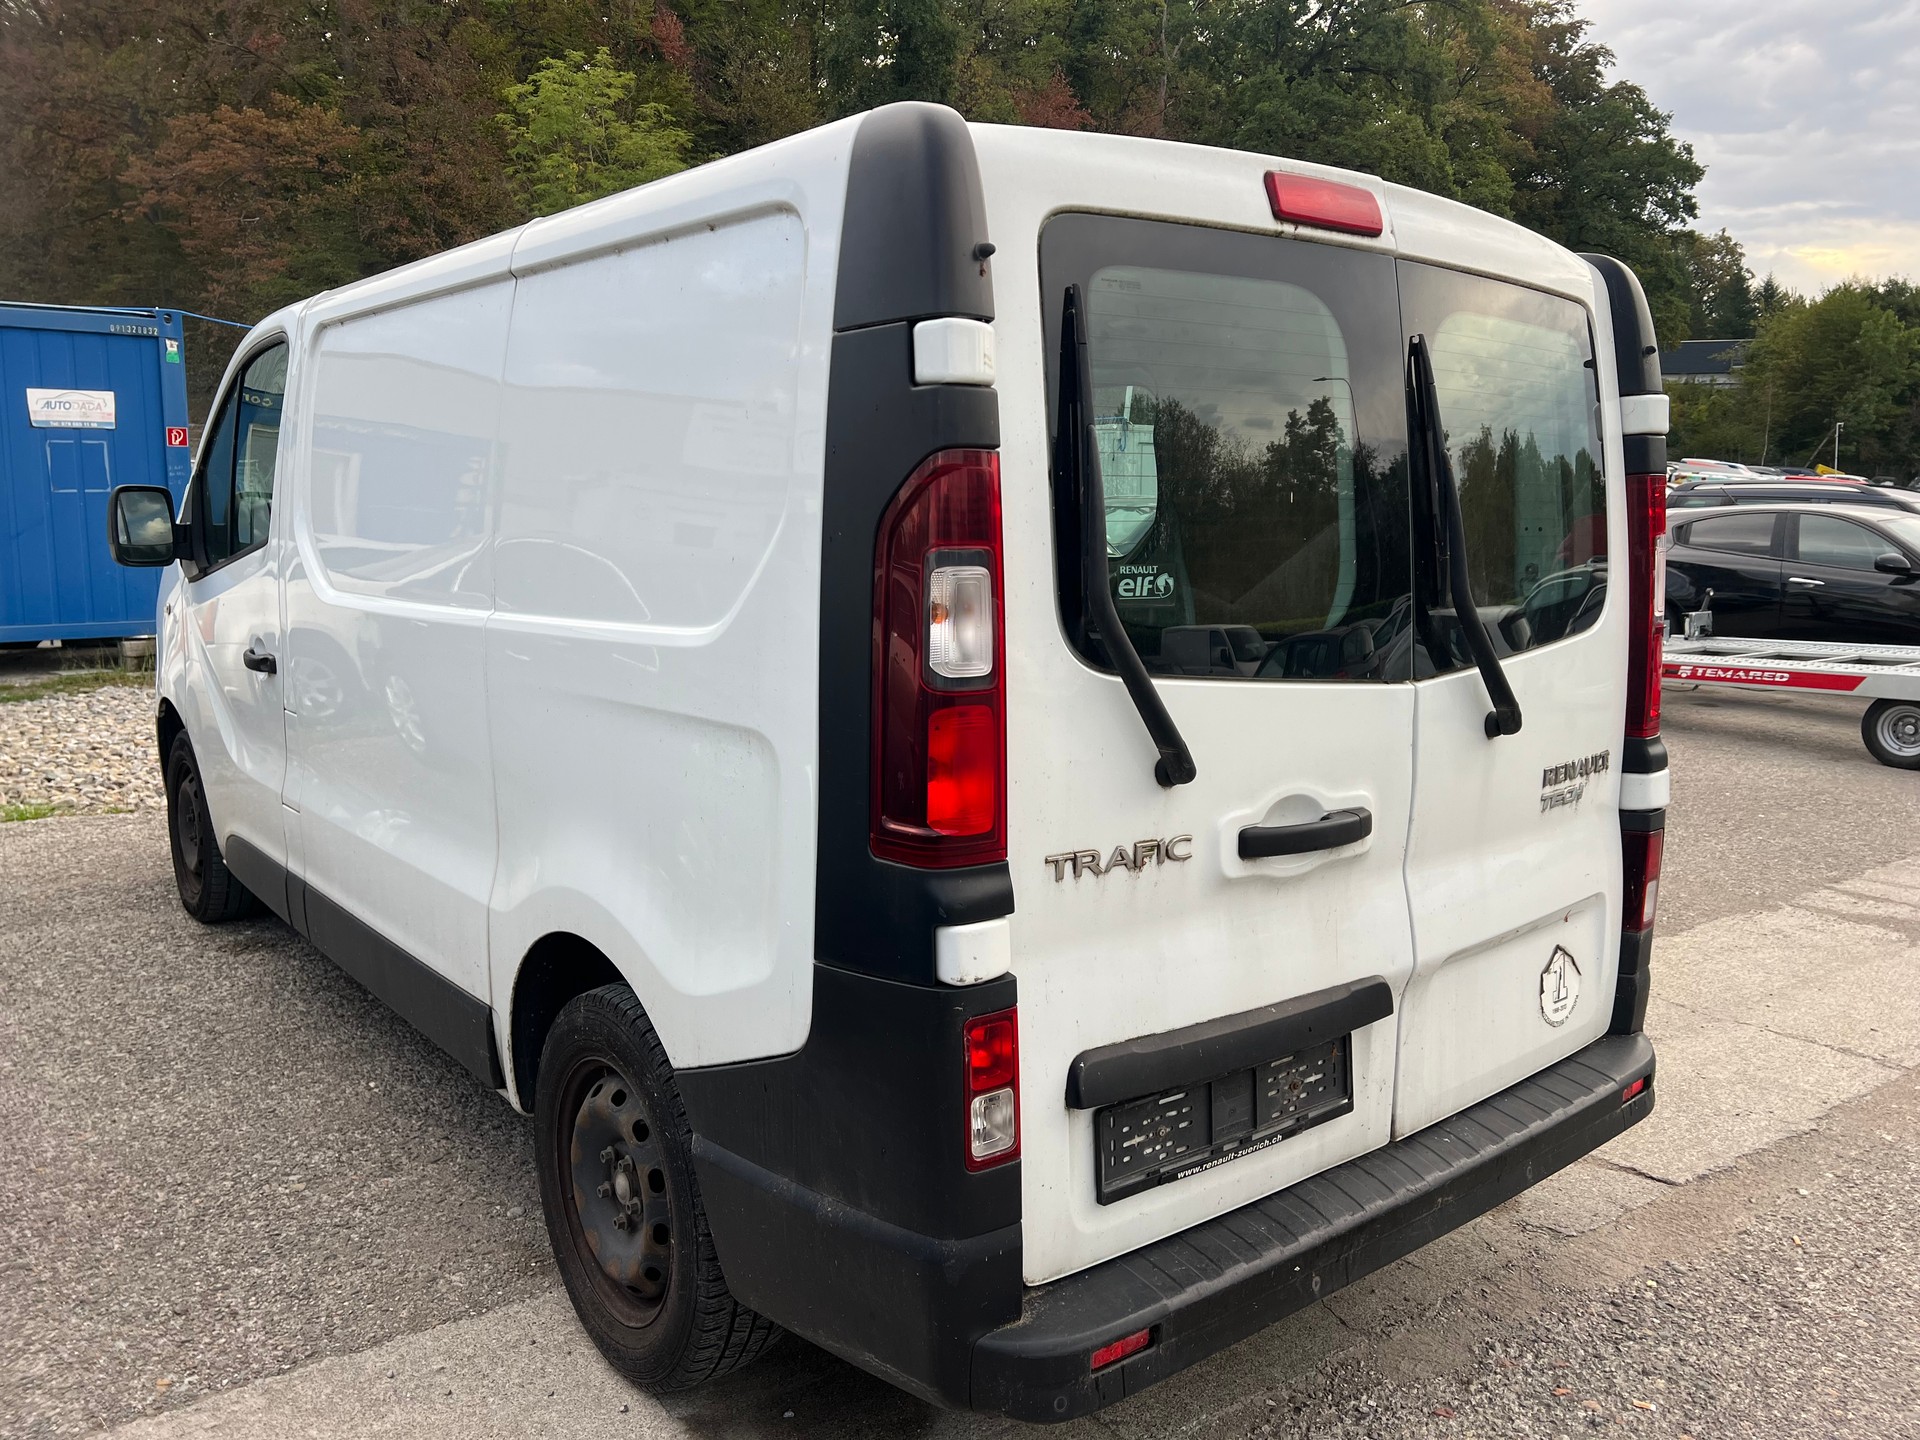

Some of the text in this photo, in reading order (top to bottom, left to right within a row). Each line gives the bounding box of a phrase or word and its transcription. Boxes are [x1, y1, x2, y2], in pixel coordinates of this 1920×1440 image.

[1120, 565, 1158, 574] RENAULT
[1118, 576, 1154, 596] elf
[1695, 667, 1790, 682] TEMARED
[1542, 750, 1610, 788] RENAULT
[1045, 834, 1193, 882] TRAFIC
[1177, 1134, 1283, 1179] www.renault-zuerich.ch
